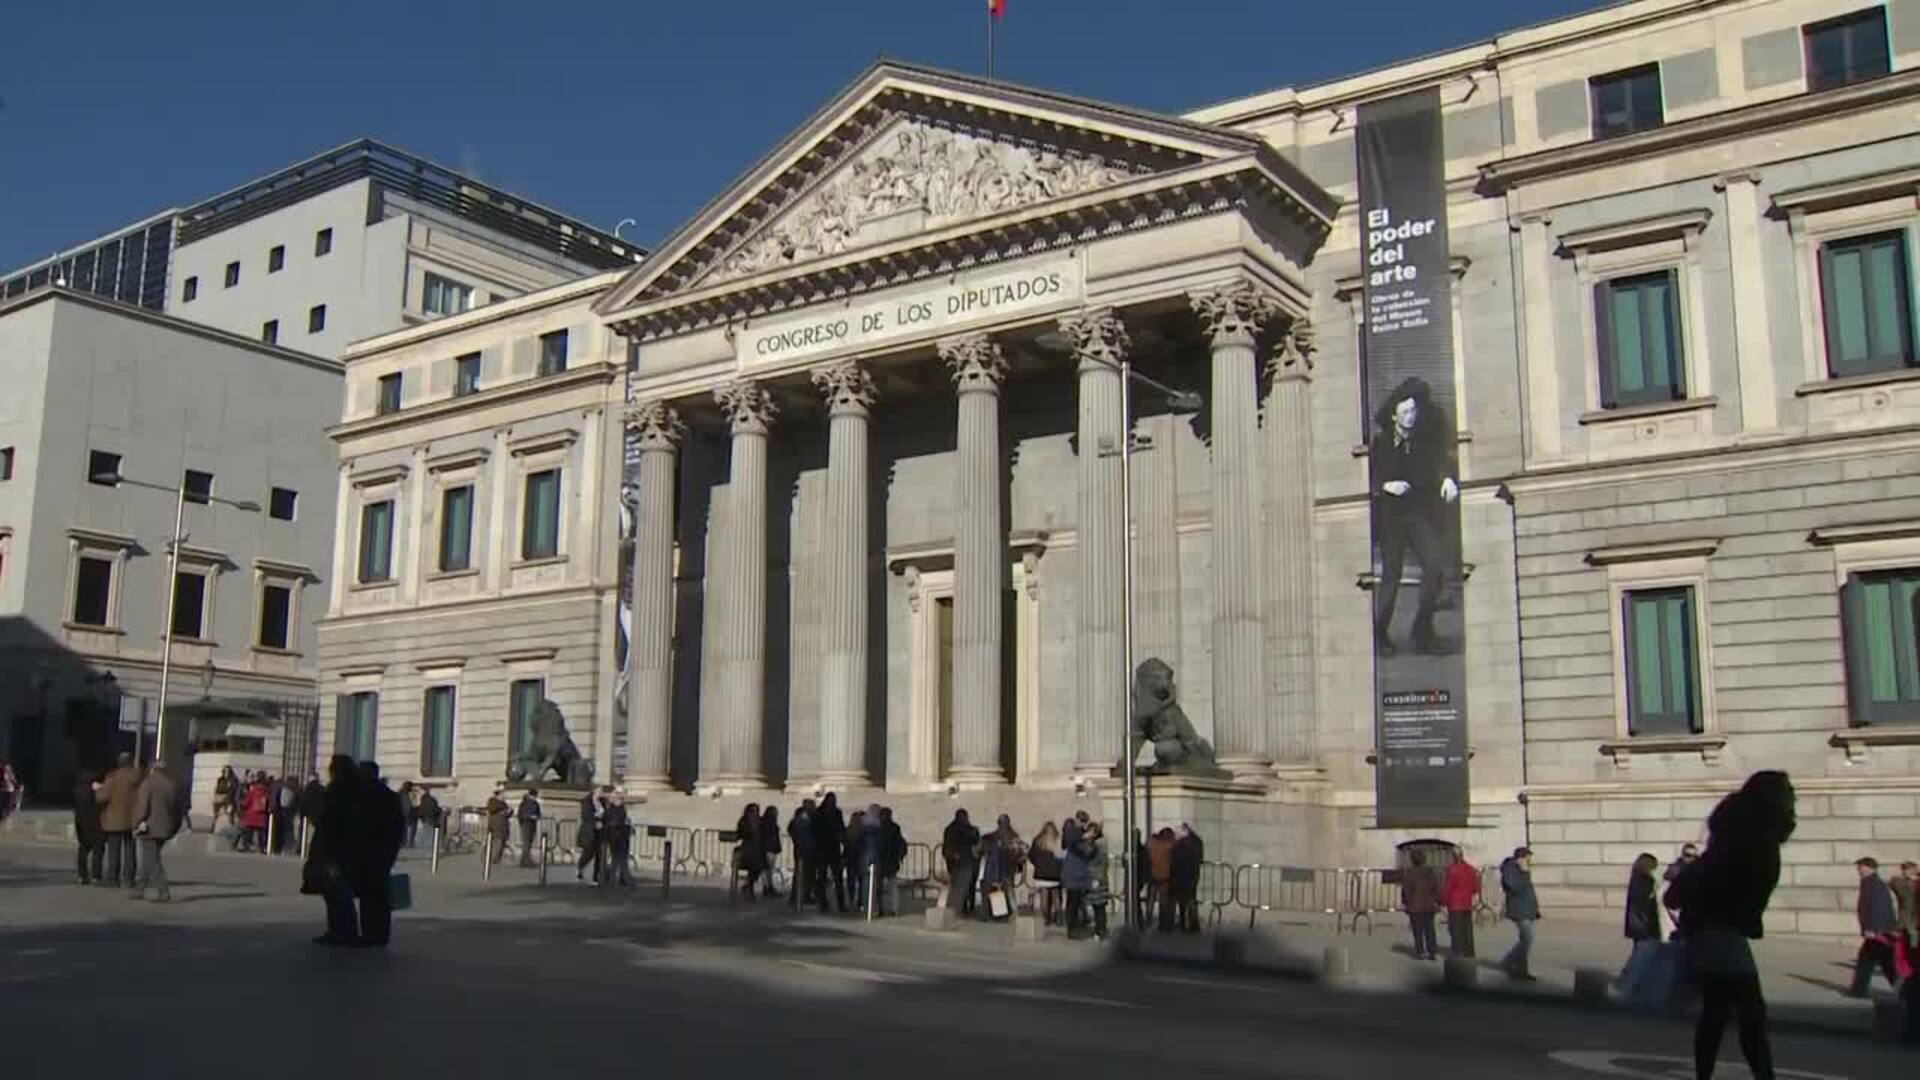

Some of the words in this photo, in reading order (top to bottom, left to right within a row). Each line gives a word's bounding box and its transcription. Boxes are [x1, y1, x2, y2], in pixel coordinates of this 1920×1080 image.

[1368, 208, 1389, 228] El
[1369, 219, 1435, 249] poder
[1369, 243, 1404, 266] del
[1370, 265, 1417, 286] arte
[755, 320, 849, 355] CONGRESO
[861, 313, 884, 334] DE
[897, 301, 932, 324] LOS
[946, 273, 1061, 315] DIPUTADOS
